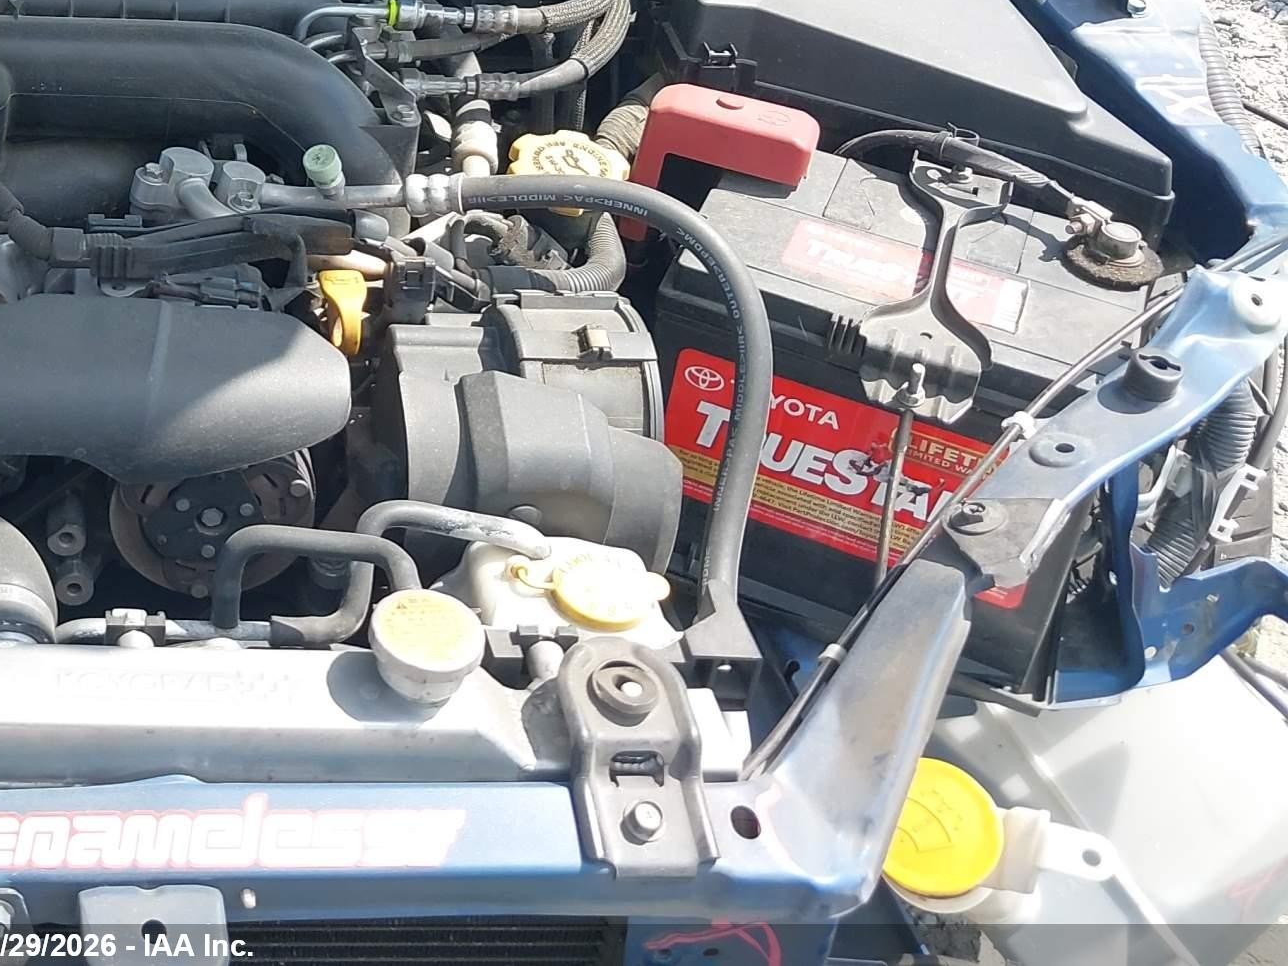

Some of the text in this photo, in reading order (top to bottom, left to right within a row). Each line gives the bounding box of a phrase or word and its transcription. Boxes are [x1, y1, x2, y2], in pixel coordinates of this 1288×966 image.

[696, 400, 955, 524] TUESTA
[909, 452, 952, 468] IMITED
[910, 438, 984, 468] LIFET
